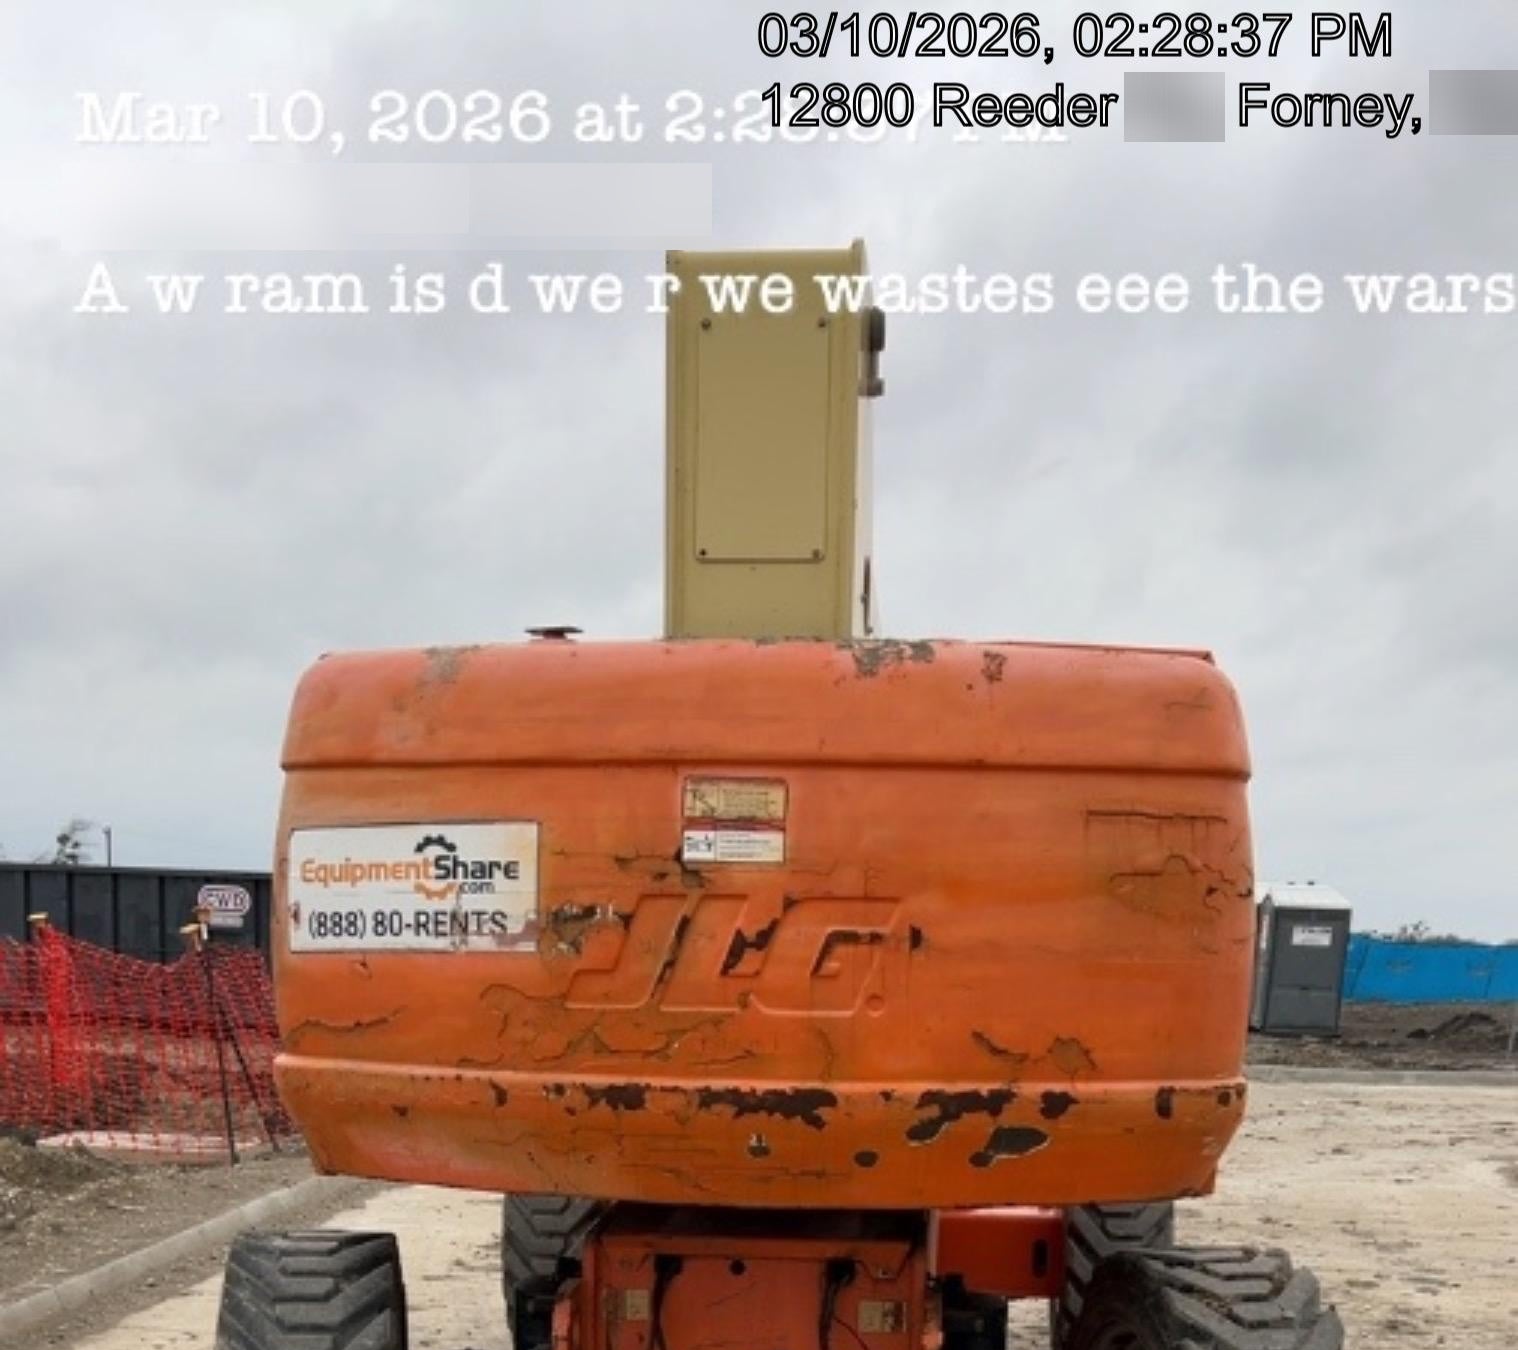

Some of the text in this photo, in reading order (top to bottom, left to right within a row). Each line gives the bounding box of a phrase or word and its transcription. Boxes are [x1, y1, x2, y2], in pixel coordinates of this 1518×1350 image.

[300, 856, 520, 888] EquipmentShare
[308, 909, 509, 939] (888) 80-RENTS
[564, 893, 904, 1017] JLG
